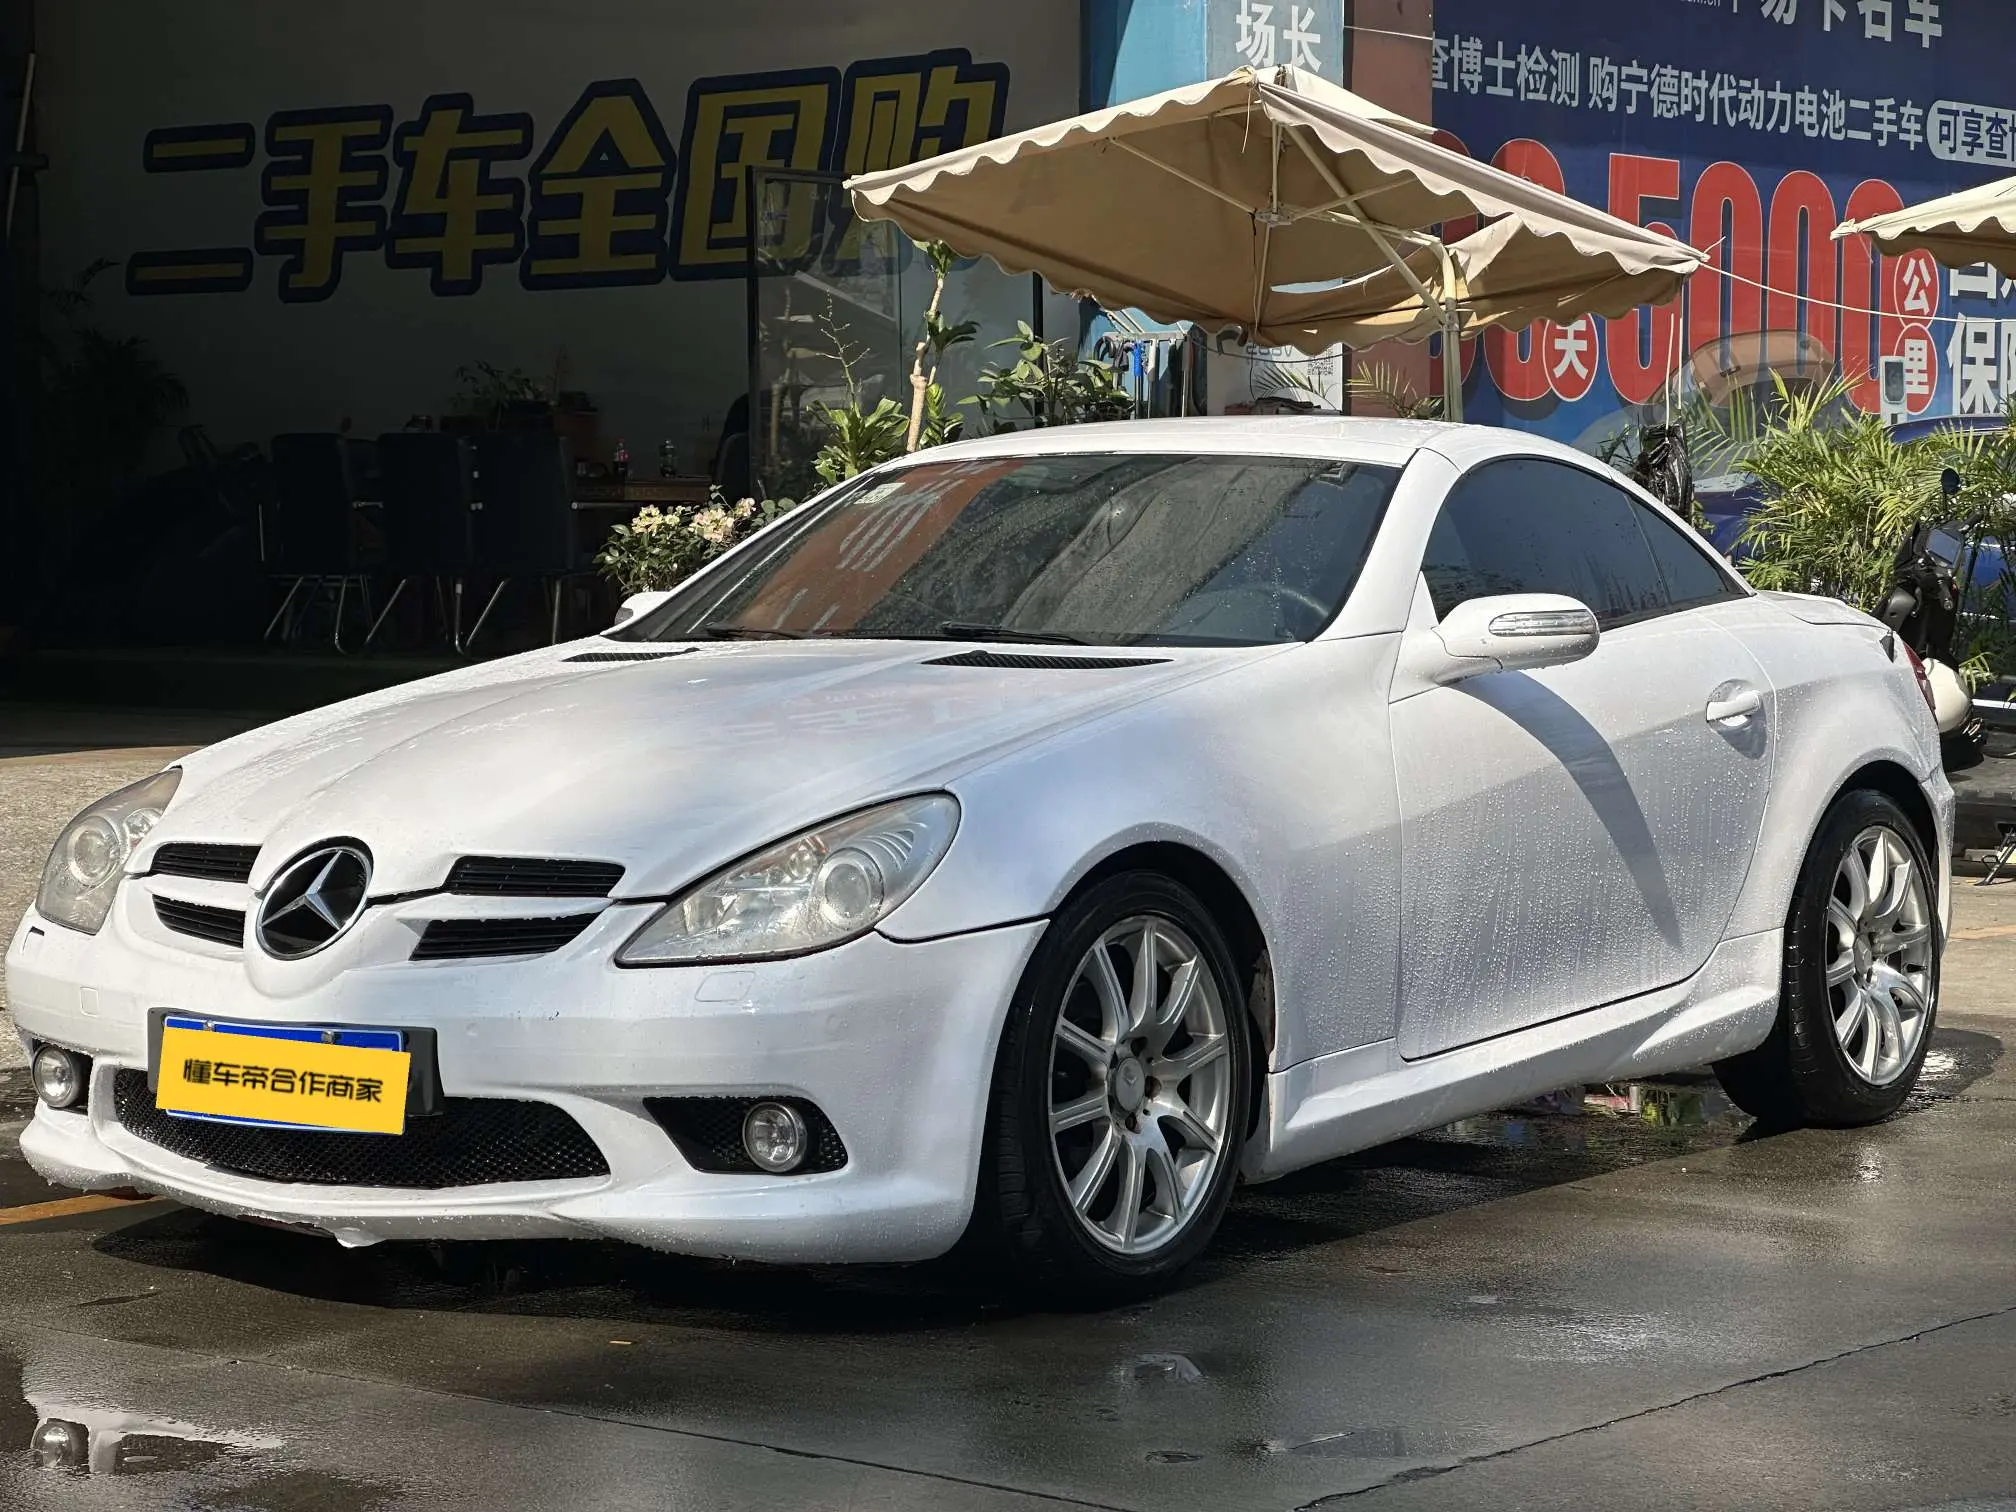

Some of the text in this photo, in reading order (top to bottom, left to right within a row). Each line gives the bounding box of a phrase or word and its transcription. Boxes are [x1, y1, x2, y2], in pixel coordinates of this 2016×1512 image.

[1588, 55, 1923, 151] 购宁德时代动力电池二手车
